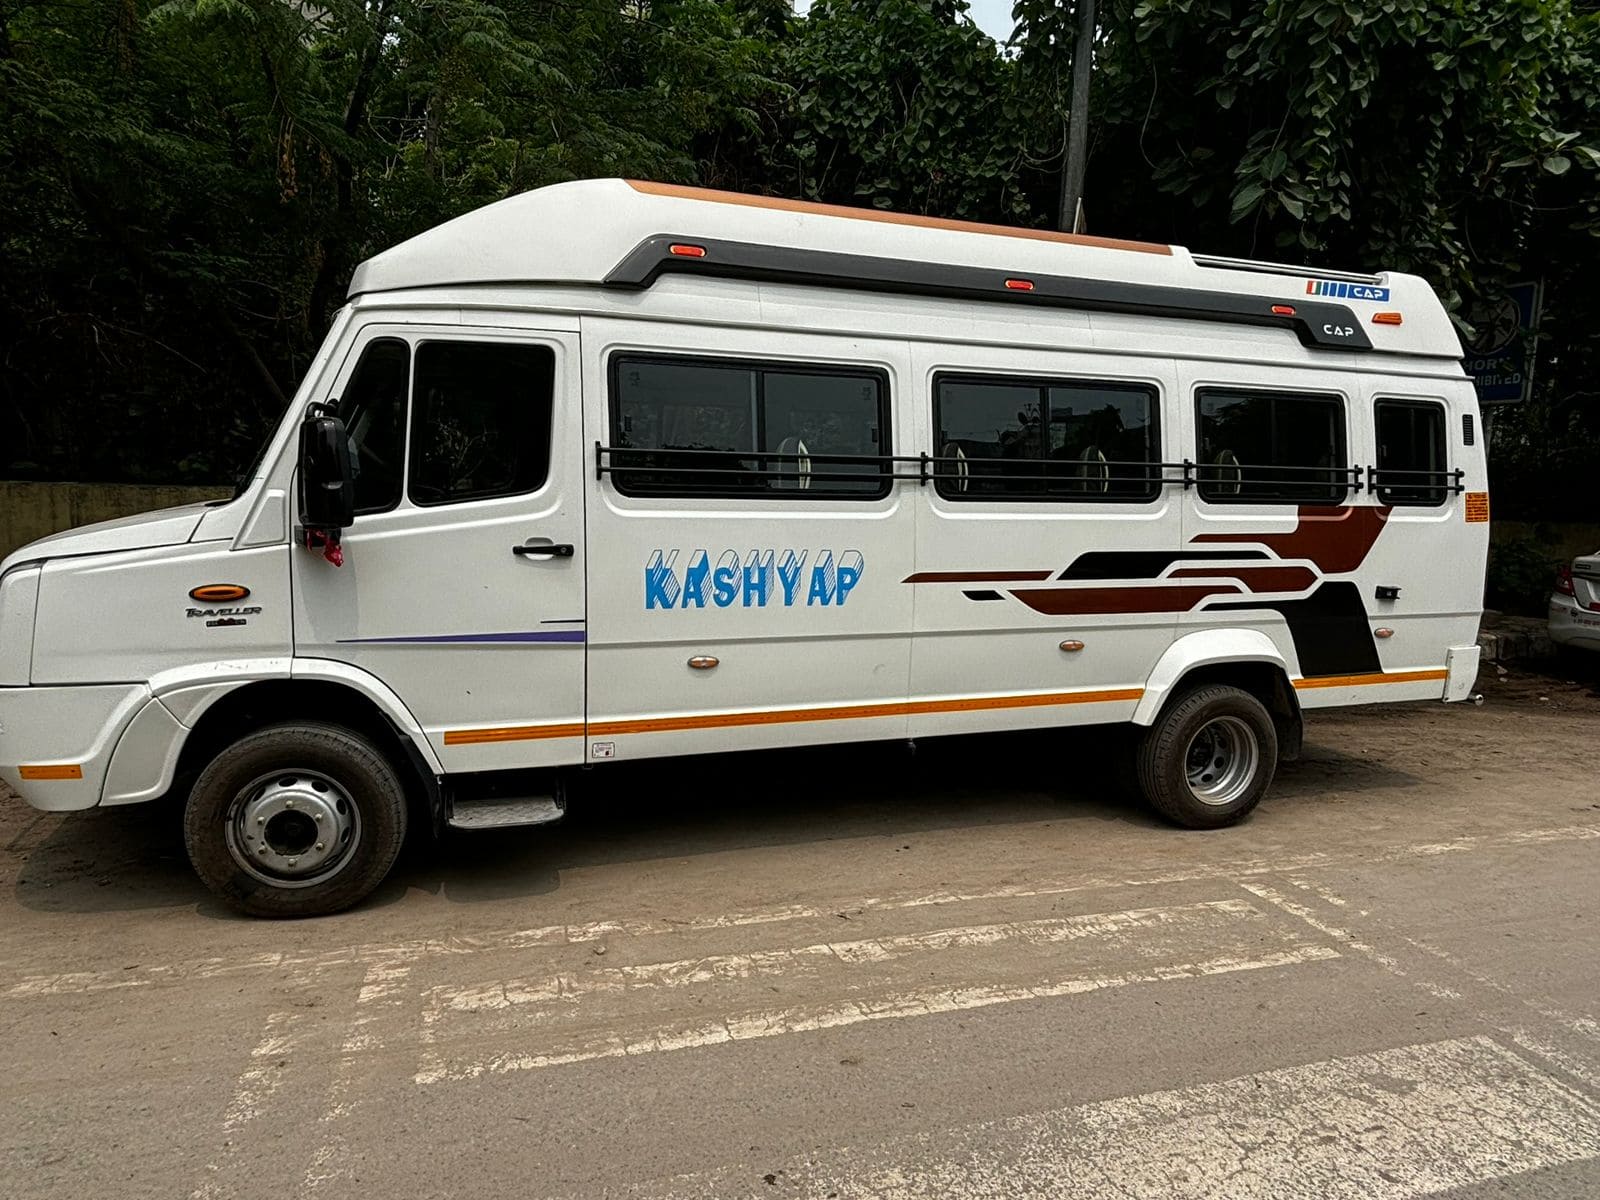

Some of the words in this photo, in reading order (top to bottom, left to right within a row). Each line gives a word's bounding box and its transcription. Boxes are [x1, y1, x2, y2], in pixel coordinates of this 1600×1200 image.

[1353, 287, 1383, 299] CAP
[1323, 324, 1354, 337] CAP
[1464, 356, 1511, 372] HOR
[645, 549, 864, 610] KASHYAP
[185, 606, 263, 618] TRAVELLER
